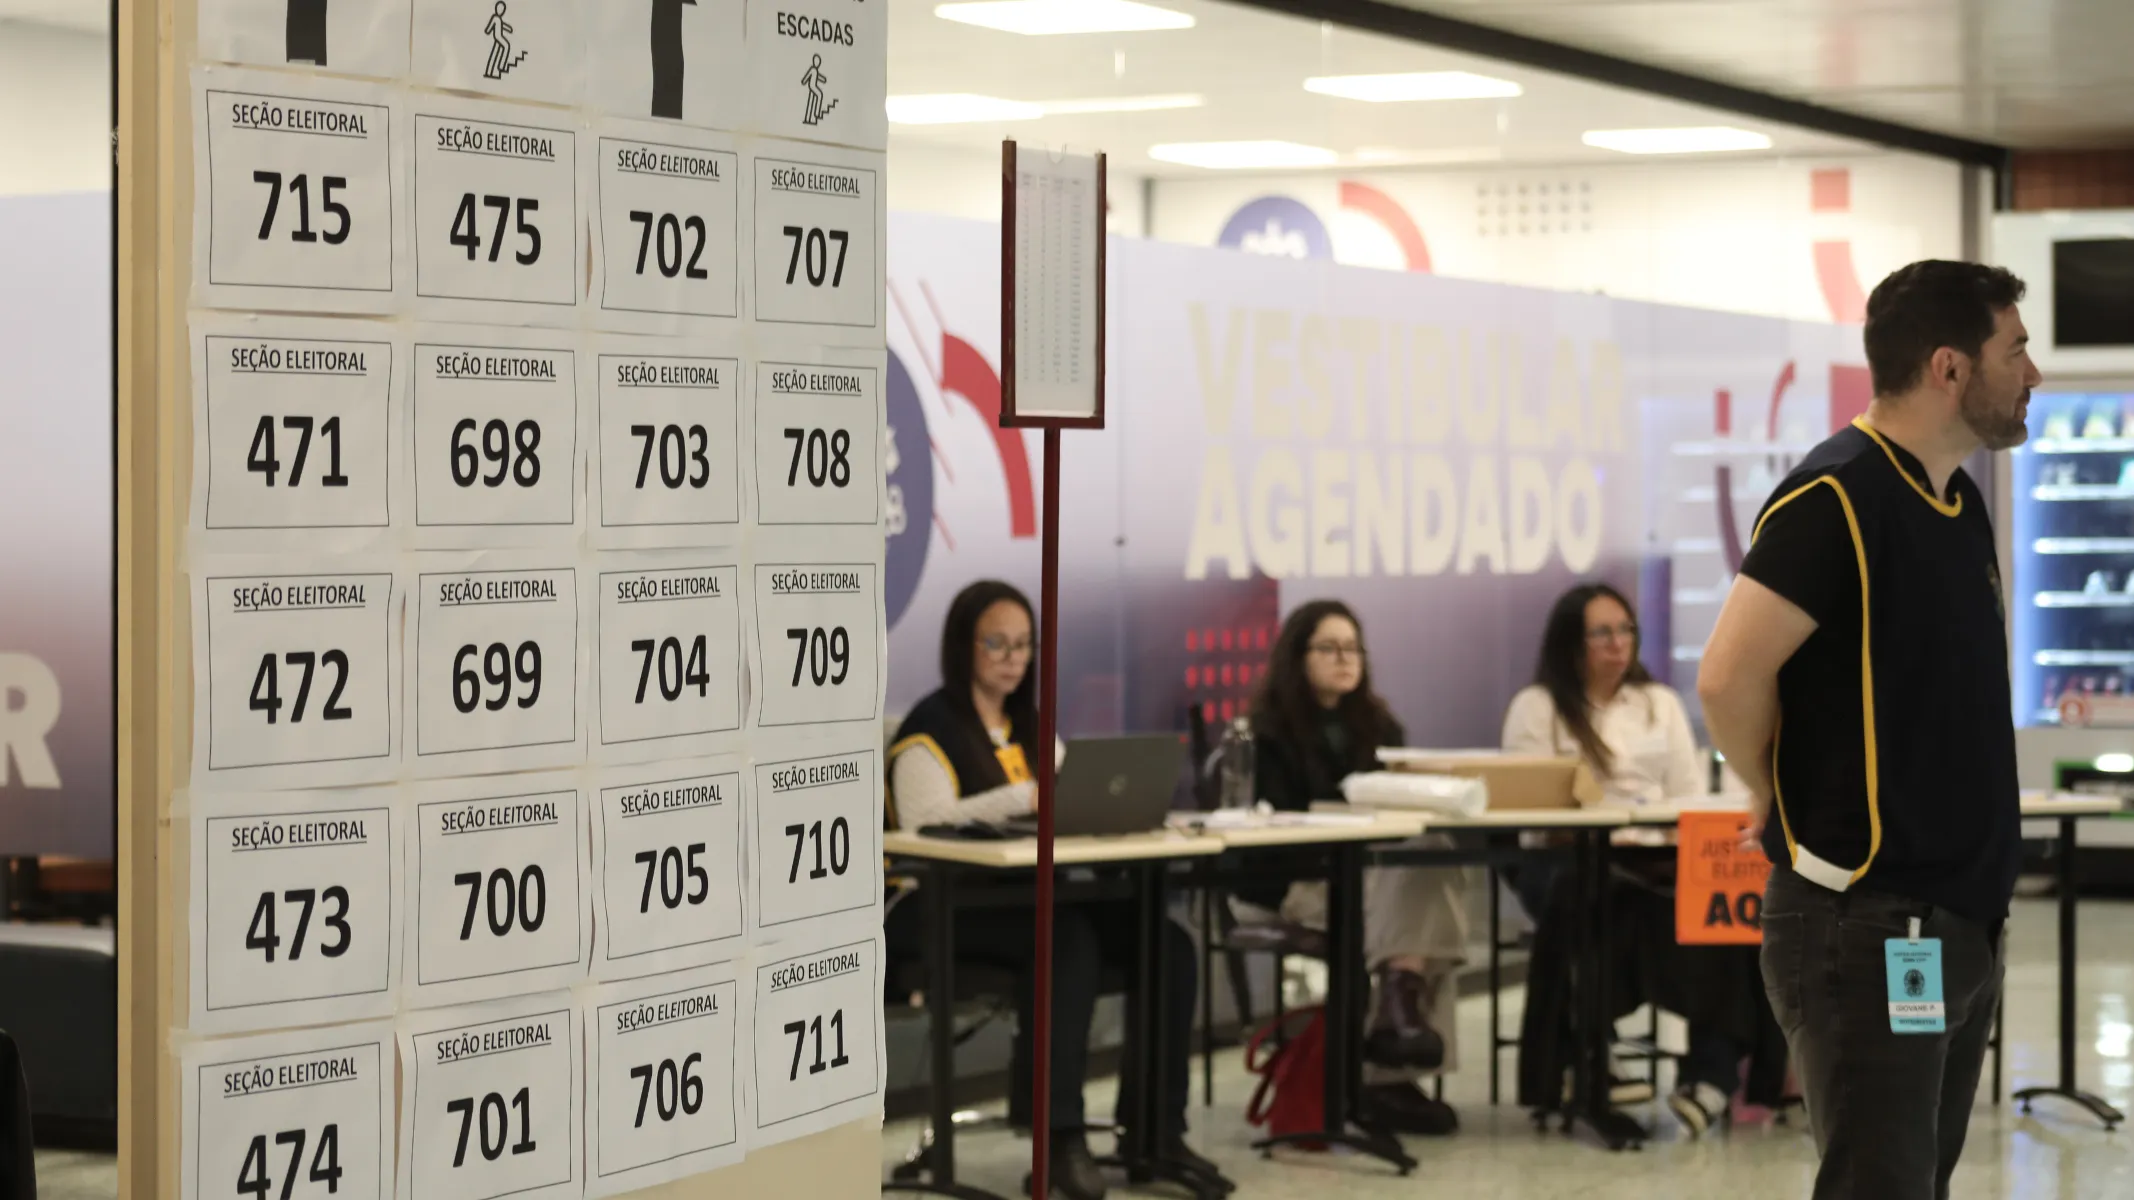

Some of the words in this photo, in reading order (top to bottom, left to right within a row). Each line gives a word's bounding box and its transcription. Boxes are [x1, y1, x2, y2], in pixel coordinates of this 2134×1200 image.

[777, 11, 854, 46] ESCADAS
[232, 101, 283, 128] SEÇÃO
[287, 108, 367, 134] ELEITORAL
[437, 126, 482, 151] SEÇÃO
[486, 133, 555, 158] ELEITORAL
[617, 148, 657, 172] SEÇÃO
[660, 154, 720, 177] ELEITORAL
[771, 167, 805, 190] SEÇÃO
[807, 173, 860, 194] ELEITORAL
[253, 170, 351, 245] 715
[449, 192, 542, 266] 475
[629, 210, 708, 280] 702
[783, 225, 849, 288] 707
[231, 344, 281, 371] SEÇÃO
[286, 350, 367, 371] ELEITORAL
[436, 352, 481, 378] SEÇÃO
[485, 356, 556, 378] ELEITORAL
[617, 361, 657, 386] SEÇÃO
[660, 366, 719, 384] ELEITORAL
[772, 369, 807, 392] SEÇÃO
[810, 373, 862, 393] ELEITORAL
[1185, 300, 1627, 451] VESTIBULAR
[247, 415, 349, 487] 471
[450, 418, 541, 488] 698
[630, 423, 710, 490] 703
[783, 427, 851, 488] 708
[1183, 445, 1604, 580] AGENDADO
[233, 582, 282, 610] SEÇÃO
[287, 585, 366, 605] ELEITORAL
[440, 578, 482, 605] SEÇÃO
[486, 579, 556, 600] ELEITORAL
[617, 576, 657, 601] SEÇÃO
[661, 576, 720, 597] ELEITORAL
[772, 569, 808, 593] SEÇÃO
[811, 573, 860, 590] ELEITORAL
[249, 648, 353, 725] 472
[452, 640, 542, 714] 699
[631, 634, 710, 704] 704
[786, 626, 850, 687] 709
[621, 789, 660, 815] SEÇÃO
[663, 784, 722, 808] ELEITORAL
[772, 765, 806, 790] SEÇÃO
[809, 761, 859, 783] ELEITORAL
[232, 821, 284, 849] SEÇÃO
[289, 820, 367, 843] ELEITORAL
[441, 806, 485, 833] SEÇÃO
[489, 802, 558, 826] ELEITORAL
[634, 842, 709, 914] 705
[785, 816, 850, 884] 710
[245, 885, 352, 963] 473
[454, 864, 546, 941] 700
[771, 963, 805, 988] SEÇÃO
[808, 952, 860, 980] ELEITORAL
[437, 1032, 480, 1061] SEÇÃO
[483, 1023, 551, 1051] ELEITORAL
[617, 1004, 654, 1030] SEÇÃO
[658, 993, 718, 1022] ELEITORAL
[224, 1065, 274, 1094] SEÇÃO
[279, 1057, 357, 1086] ELEITORAL
[783, 1008, 849, 1082] 711
[630, 1052, 704, 1129] 706
[446, 1086, 537, 1168] 701
[236, 1123, 343, 1200] 474
